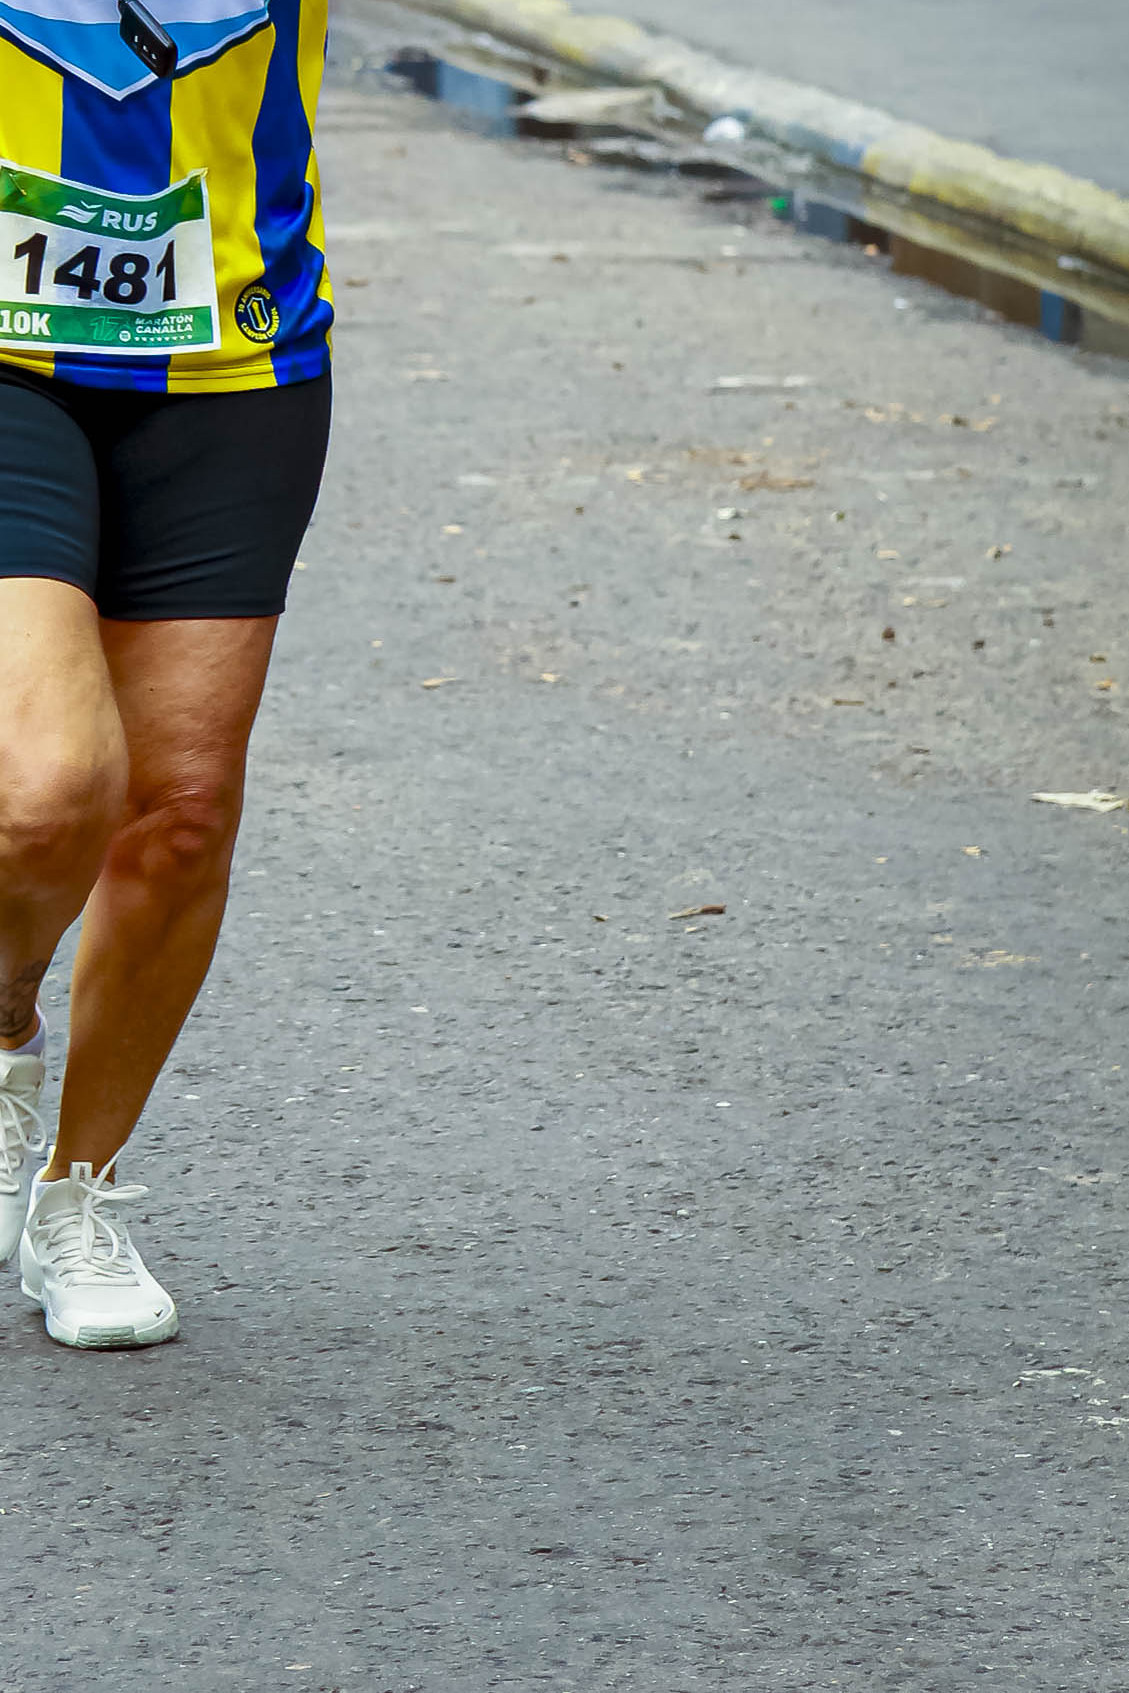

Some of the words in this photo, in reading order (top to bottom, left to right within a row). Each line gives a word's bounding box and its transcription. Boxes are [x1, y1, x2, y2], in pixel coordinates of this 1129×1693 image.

[101, 209, 158, 231] RUS
[14, 233, 177, 305] 1481
[0, 309, 51, 336] 10K
[135, 313, 194, 326] MARATÓN
[135, 323, 194, 334] CANALLA
